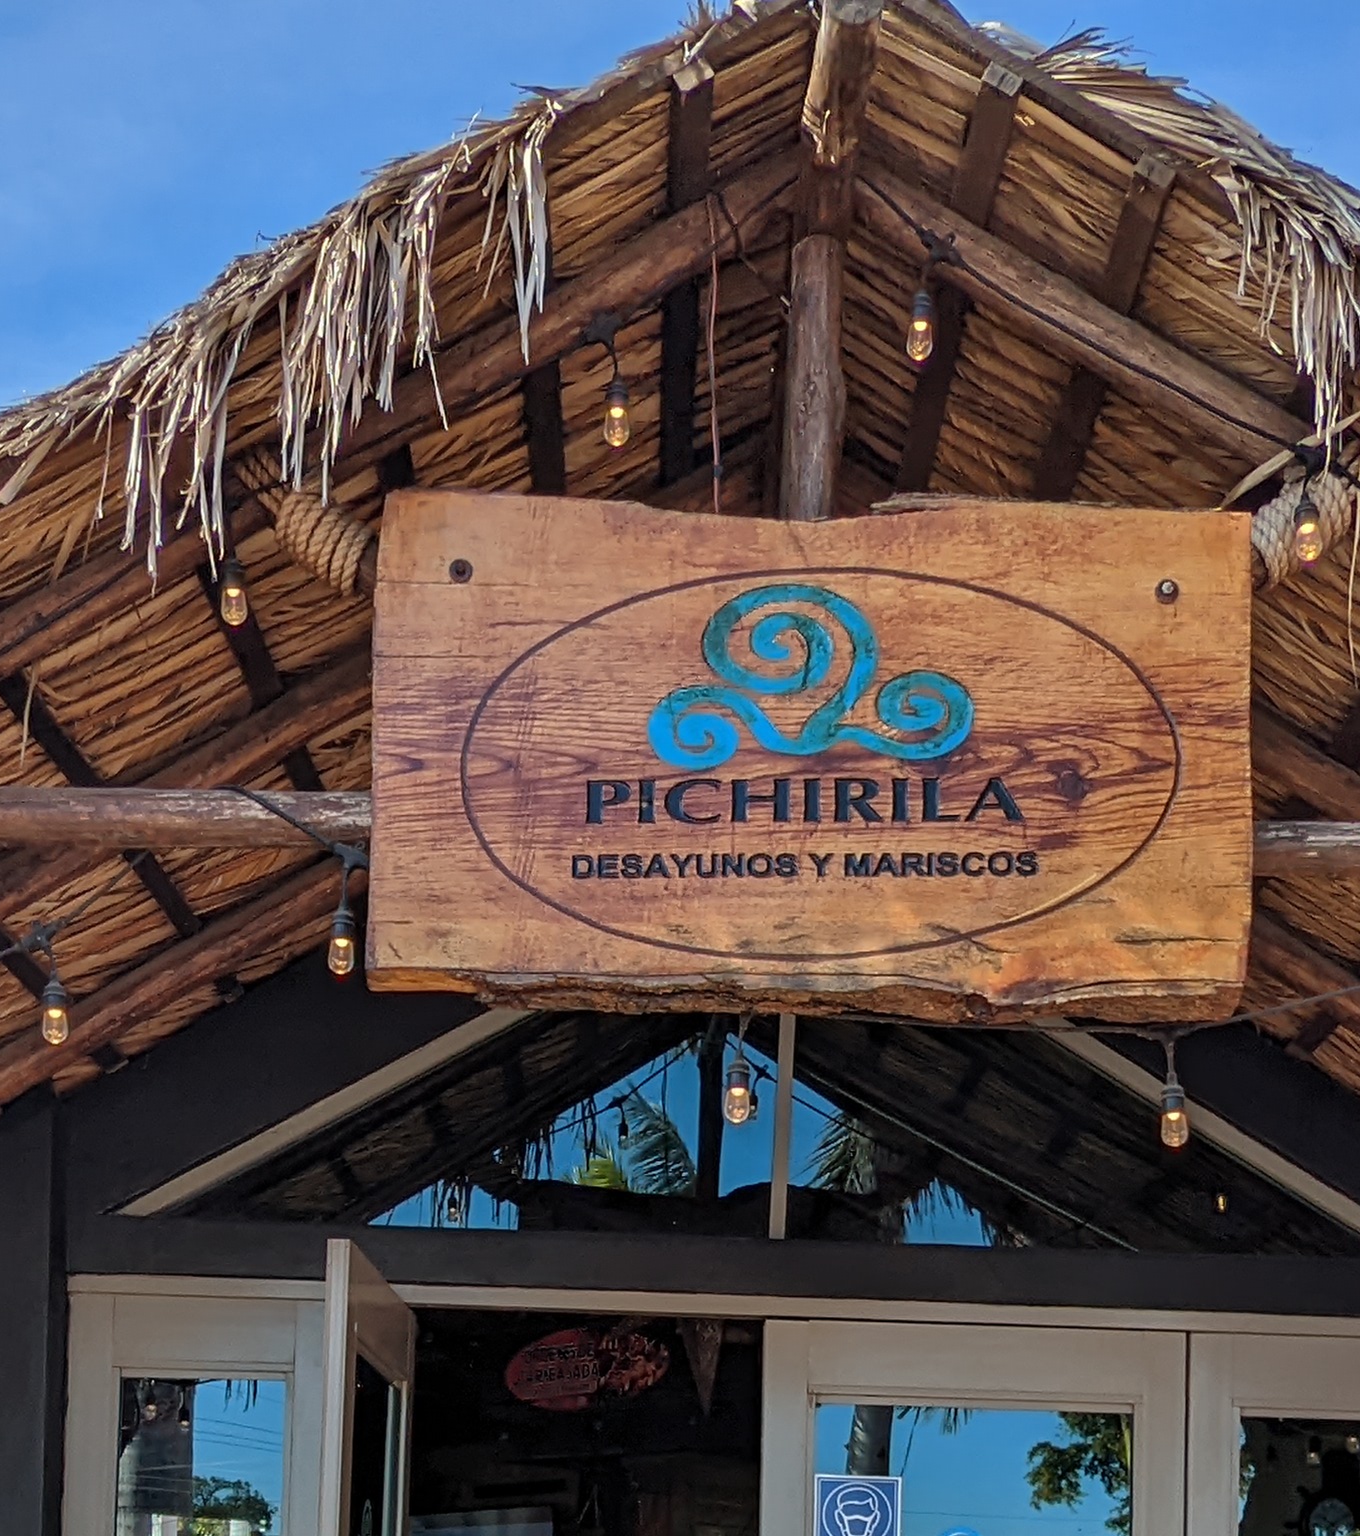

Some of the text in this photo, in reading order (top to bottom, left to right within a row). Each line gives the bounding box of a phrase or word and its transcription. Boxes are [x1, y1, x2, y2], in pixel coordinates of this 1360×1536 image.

[585, 777, 1027, 825] PICHIRILA
[571, 850, 1040, 879] DESAYUNOS Y MARISCOS
